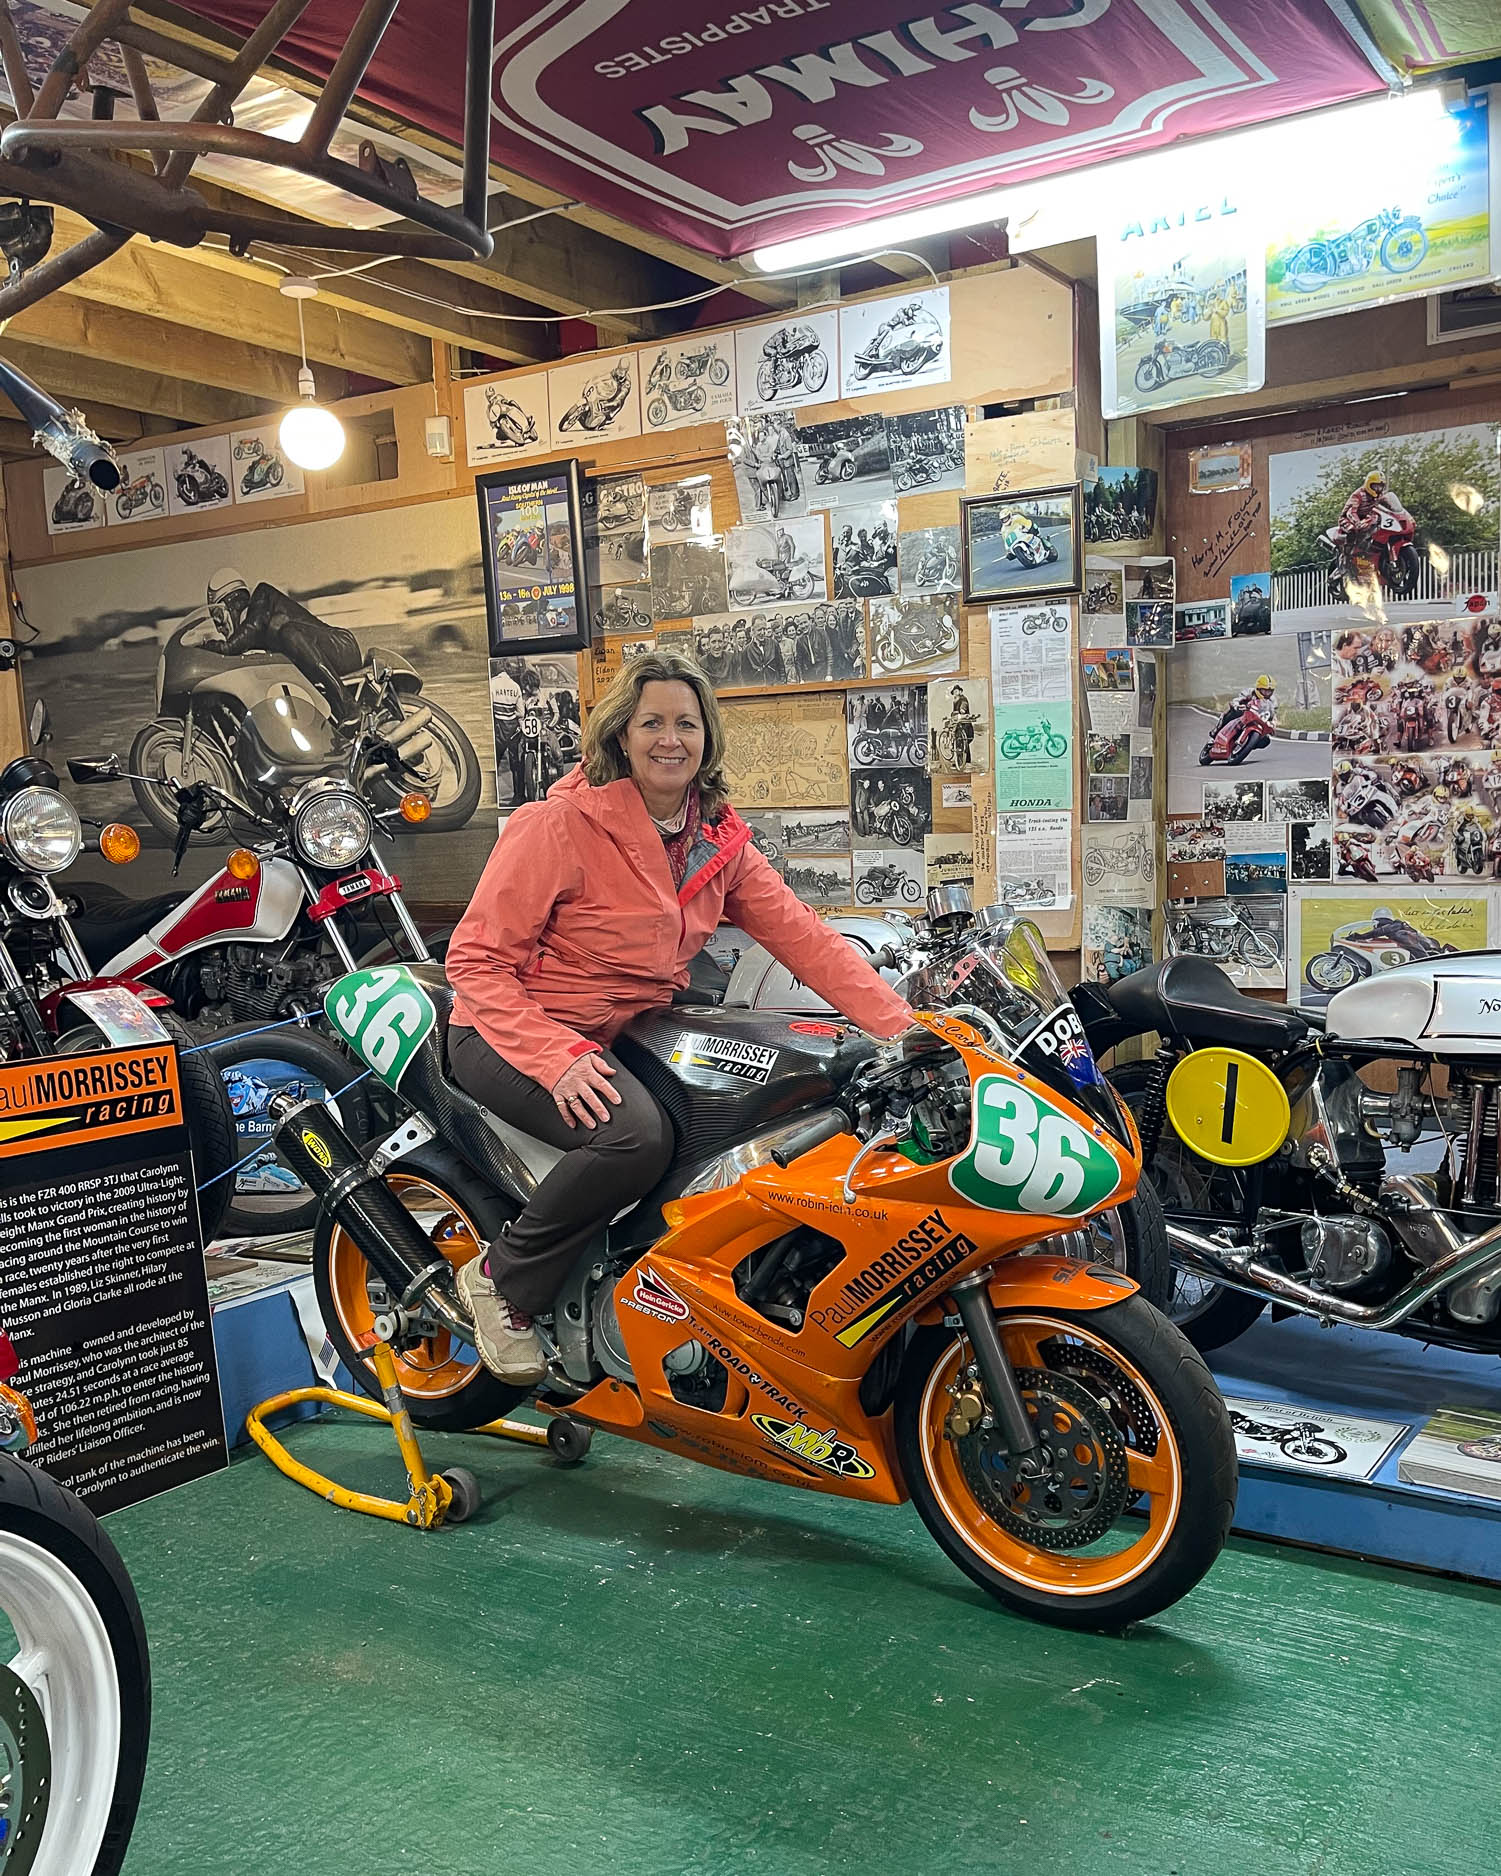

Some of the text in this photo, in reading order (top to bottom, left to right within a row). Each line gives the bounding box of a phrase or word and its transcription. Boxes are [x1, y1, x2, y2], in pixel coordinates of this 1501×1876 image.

[594, 0, 830, 79] TRAPPISTES
[642, 0, 1103, 156] CHIMAY
[531, 480, 548, 490] MAN
[1382, 517, 1394, 528] 3
[542, 585, 557, 596] JULY
[524, 719, 538, 735] 58
[1009, 799, 1052, 807] HONDA
[343, 880, 367, 893] YAMAHA
[335, 968, 421, 1076] 36
[716, 1061, 767, 1080] racing
[85, 1093, 171, 1124] racing
[1221, 1062, 1239, 1145] 1
[974, 1082, 1090, 1213] 36
[9, 1196, 17, 1206] is
[19, 1193, 36, 1204] the
[38, 1187, 56, 1200] FZR
[58, 1183, 76, 1195] 400
[78, 1178, 101, 1191] RRSP
[103, 1174, 118, 1186] 3TJ
[120, 1171, 138, 1182] that
[140, 1164, 178, 1178] Carolynn
[13, 1207, 36, 1220] took
[38, 1206, 48, 1214] to
[50, 1198, 83, 1211] victory
[84, 1195, 94, 1204] in
[96, 1191, 111, 1202] the
[113, 1185, 135, 1198] 2009
[28, 1219, 55, 1232] Manx
[56, 1209, 86, 1225] Grand
[108, 1199, 144, 1213] creating
[146, 1192, 176, 1204] history
[177, 1188, 188, 1198] by
[44, 1232, 61, 1242] the
[63, 1227, 81, 1238] first
[82, 1219, 117, 1233] woman
[119, 1215, 128, 1224] in
[130, 1212, 145, 1222] the
[146, 1205, 176, 1218] history
[178, 1200, 186, 1211] of
[5, 1233, 169, 1282] race, twenty years after the very first
[28, 1244, 63, 1261] around
[64, 1242, 80, 1252] the
[82, 1231, 127, 1248] Mountain
[128, 1223, 159, 1236] Course
[160, 1220, 170, 1228] to
[171, 1216, 187, 1225] win
[38, 1265, 92, 1288] established
[94, 1263, 110, 1273] the
[112, 1256, 133, 1269] right
[135, 1254, 145, 1263] to
[146, 1244, 184, 1260] compete
[186, 1241, 194, 1249] at
[902, 1236, 972, 1296] racing
[0, 1262, 166, 1313] the Manx. In 1989, Liz Skinner, Hilary
[1, 1272, 182, 1331] Musson and Gloria Clarke all rode at the
[620, 1297, 678, 1325] PRESTON
[708, 1338, 751, 1375] ROAD
[760, 1381, 808, 1419] TRACK
[79, 1435, 111, 1452] Liaison
[113, 1423, 145, 1439] Officer.
[1299, 1412, 1334, 1423] British
[74, 1438, 219, 1498] Carolynn to authenticate the win.
